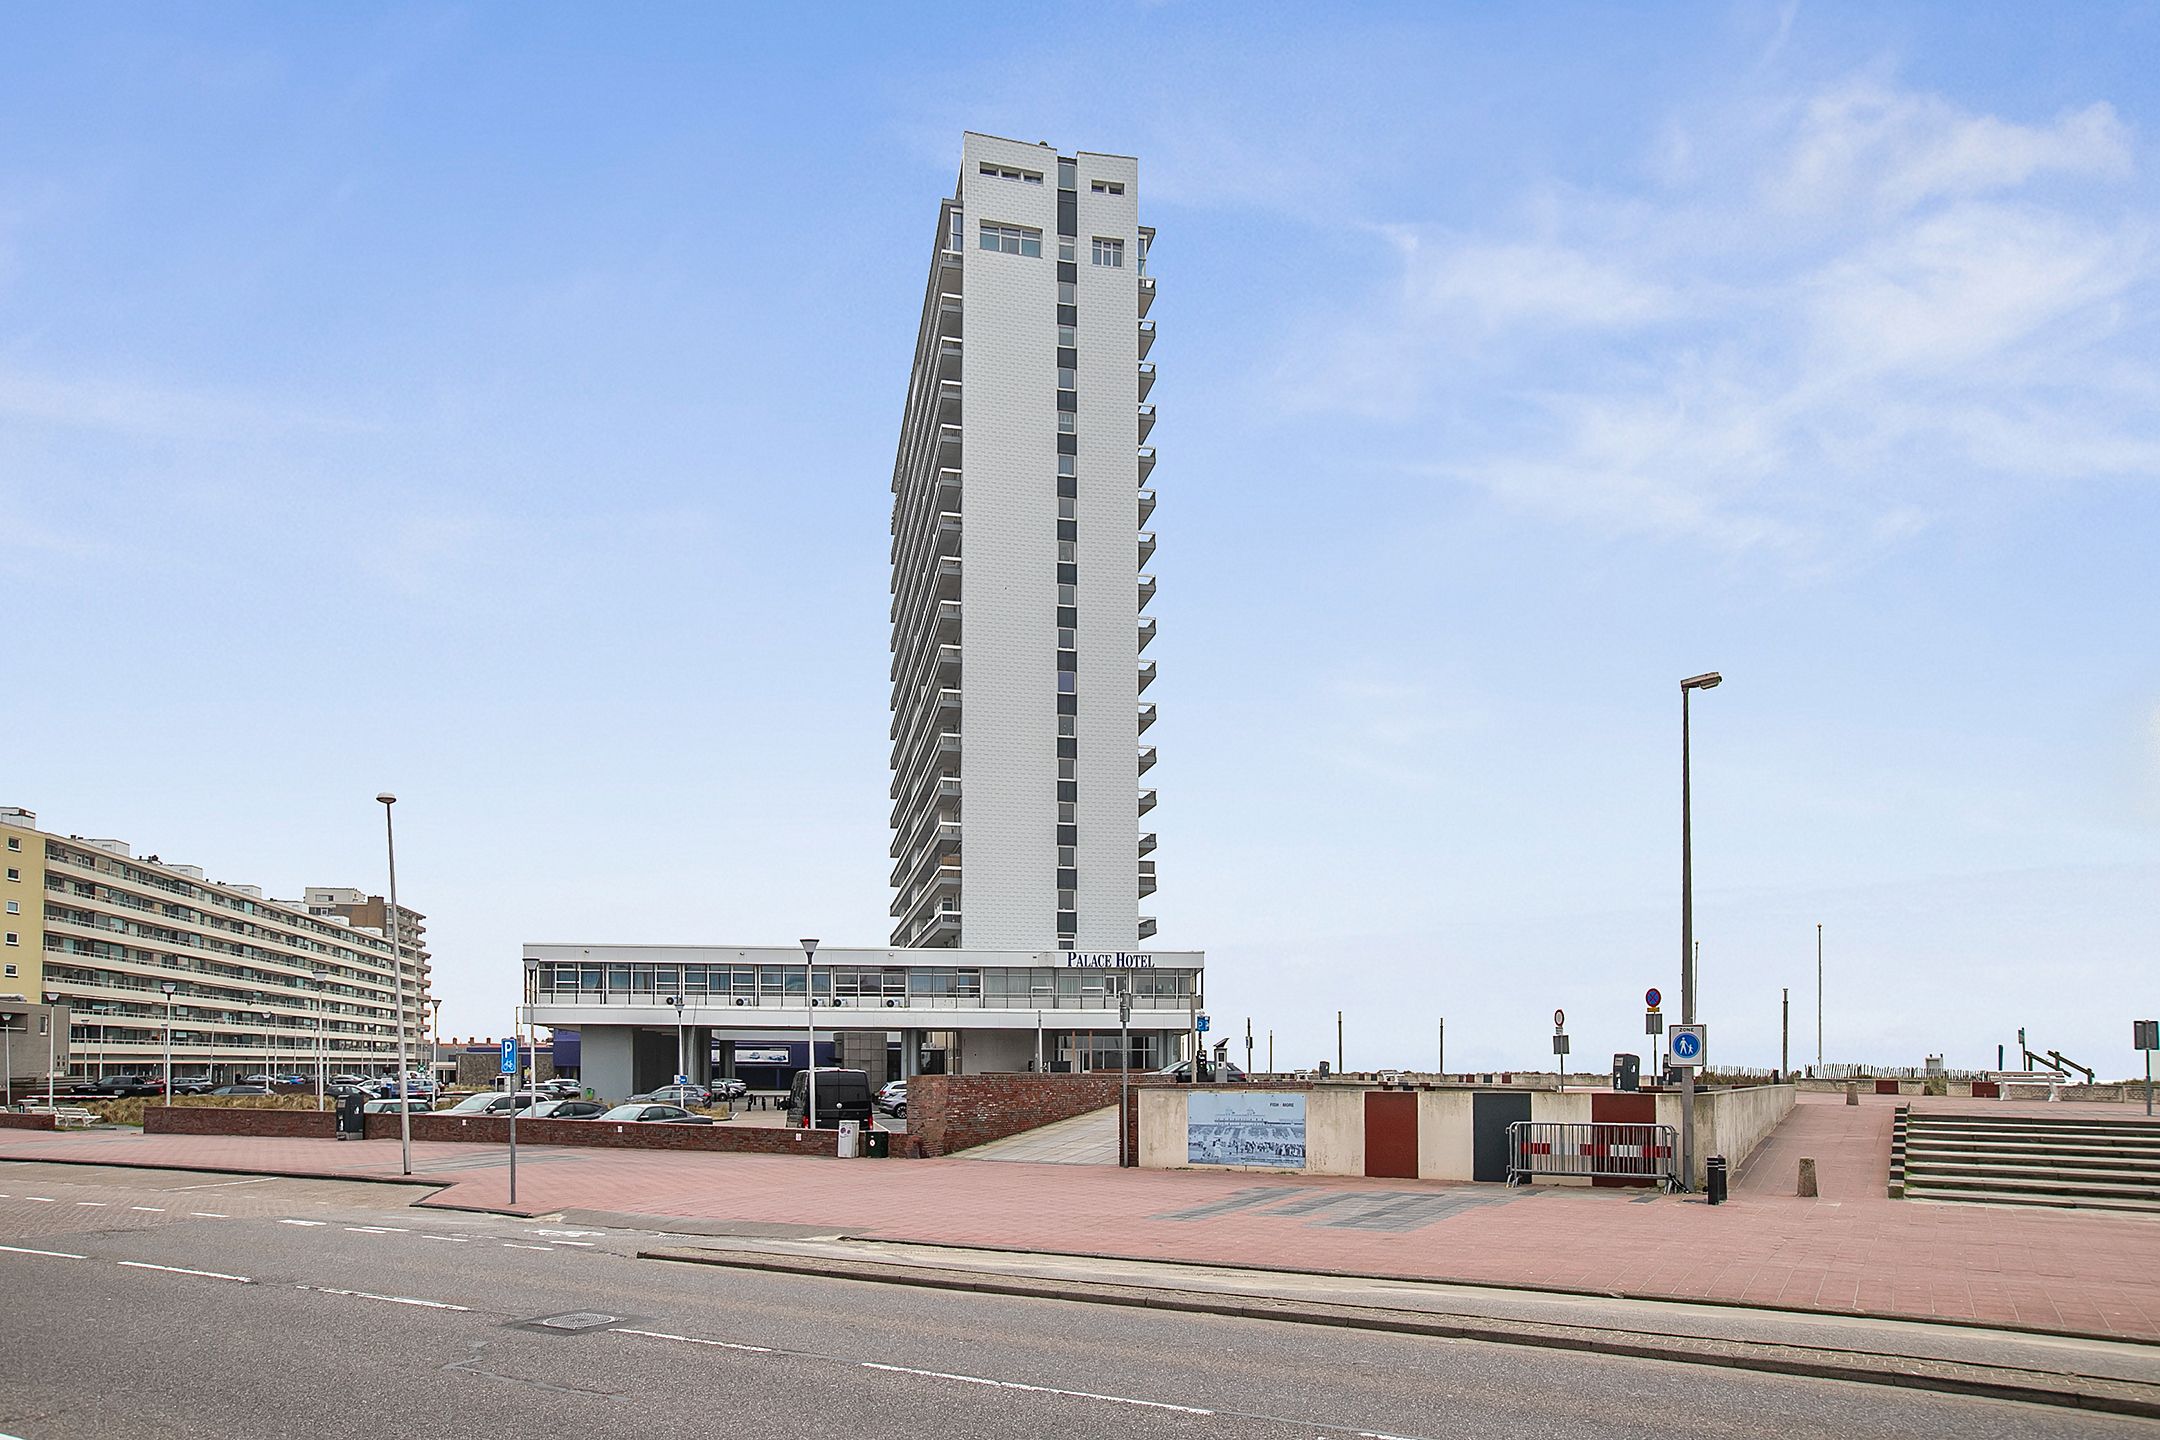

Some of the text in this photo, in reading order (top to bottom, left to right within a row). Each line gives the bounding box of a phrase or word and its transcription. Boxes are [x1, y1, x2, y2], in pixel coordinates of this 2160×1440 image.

[1067, 952, 1155, 968] PALACE HOTEL
[505, 1042, 512, 1058] P
